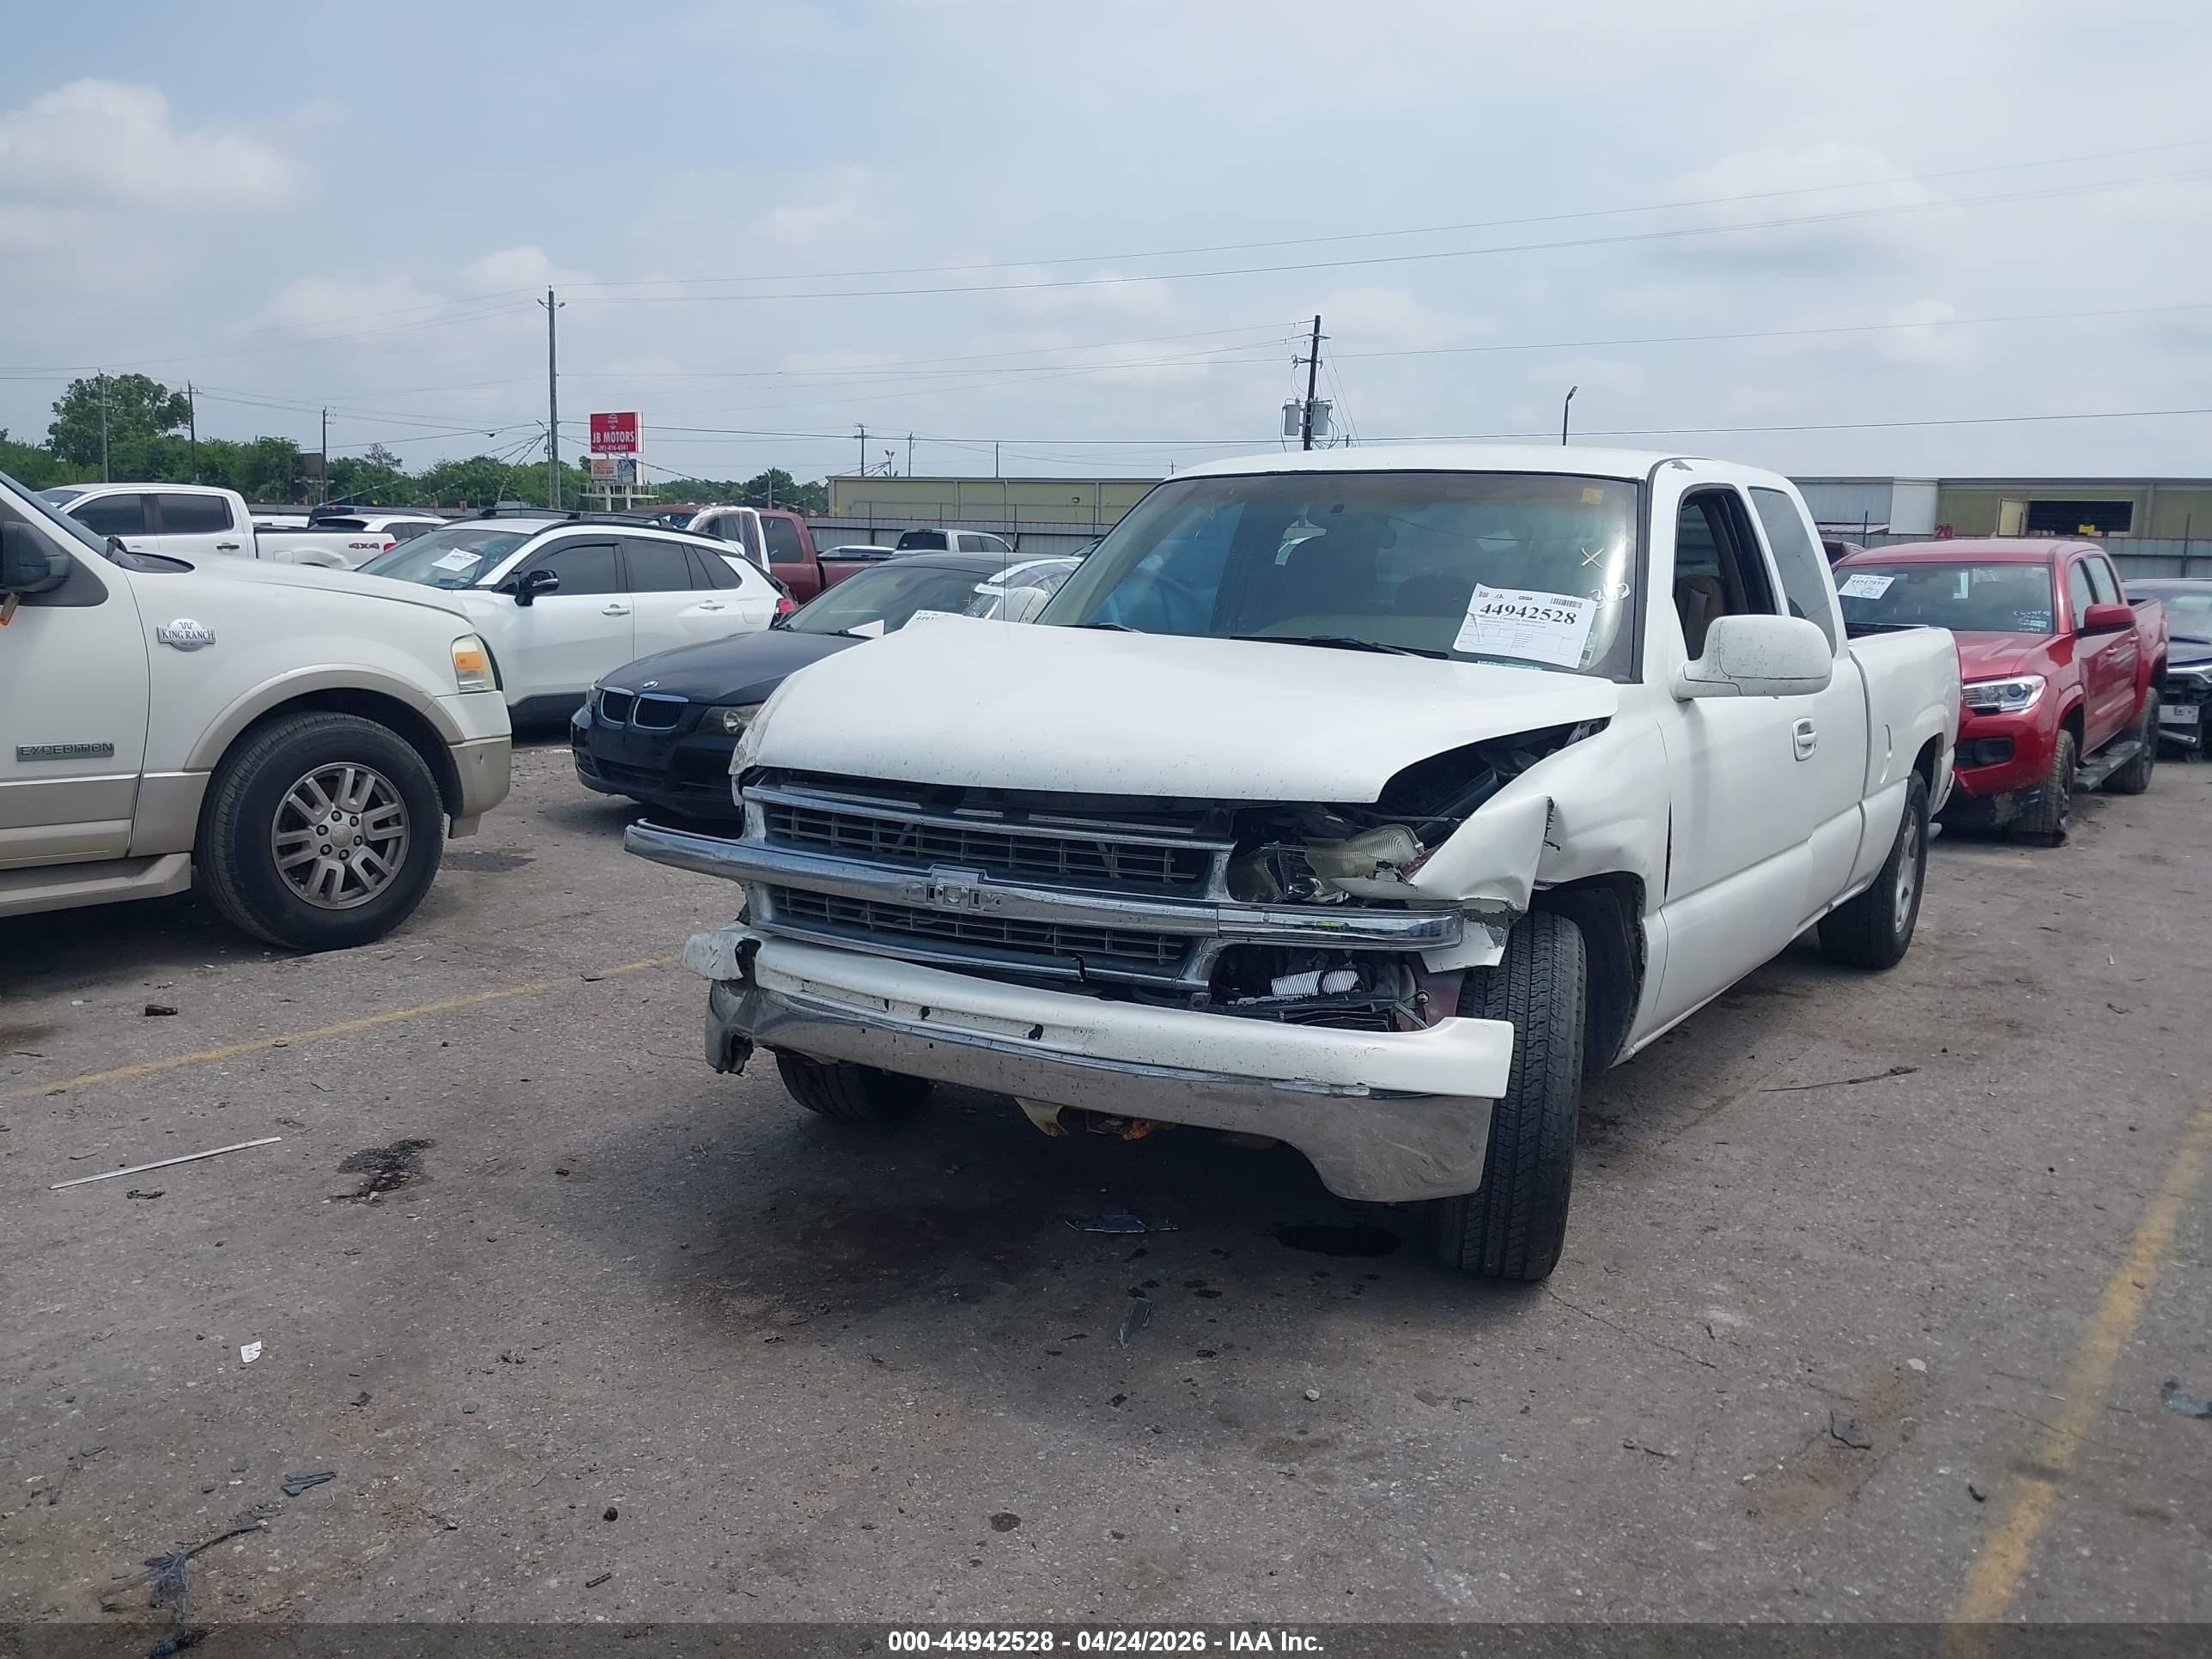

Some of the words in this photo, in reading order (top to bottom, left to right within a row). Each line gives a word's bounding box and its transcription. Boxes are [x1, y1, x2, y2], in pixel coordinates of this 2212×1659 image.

[592, 432, 601, 443] JB
[604, 431, 635, 443] MOTORS
[1480, 604, 1577, 625] 44942528
[161, 629, 184, 640] KING
[185, 629, 215, 640] RANCH
[20, 744, 112, 757] EXPEDITION
